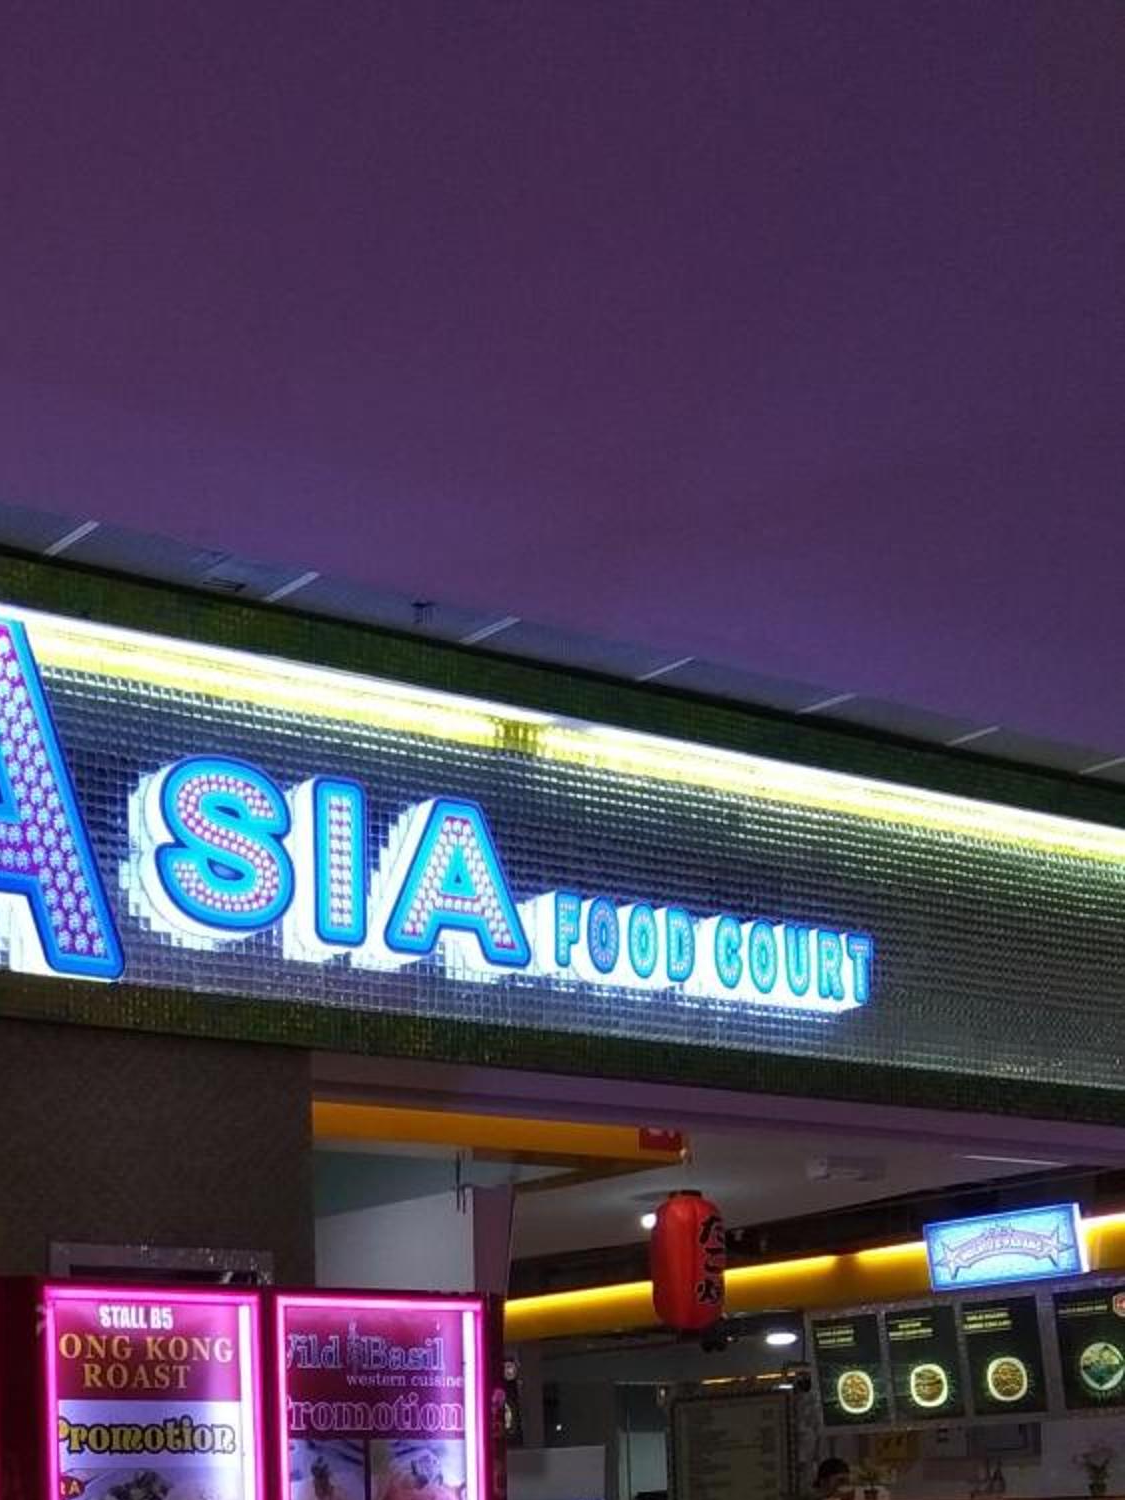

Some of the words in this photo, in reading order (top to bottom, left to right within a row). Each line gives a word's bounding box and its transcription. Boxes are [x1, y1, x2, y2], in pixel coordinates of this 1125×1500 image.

[552, 891, 694, 983] FOOD
[714, 915, 872, 1004] COURT
[98, 1304, 147, 1329] STALL
[59, 1333, 134, 1360] ONG
[146, 1335, 235, 1363] KONG
[83, 1363, 191, 1390] ROAST
[347, 1372, 407, 1388] western
[287, 1391, 463, 1432] romotion
